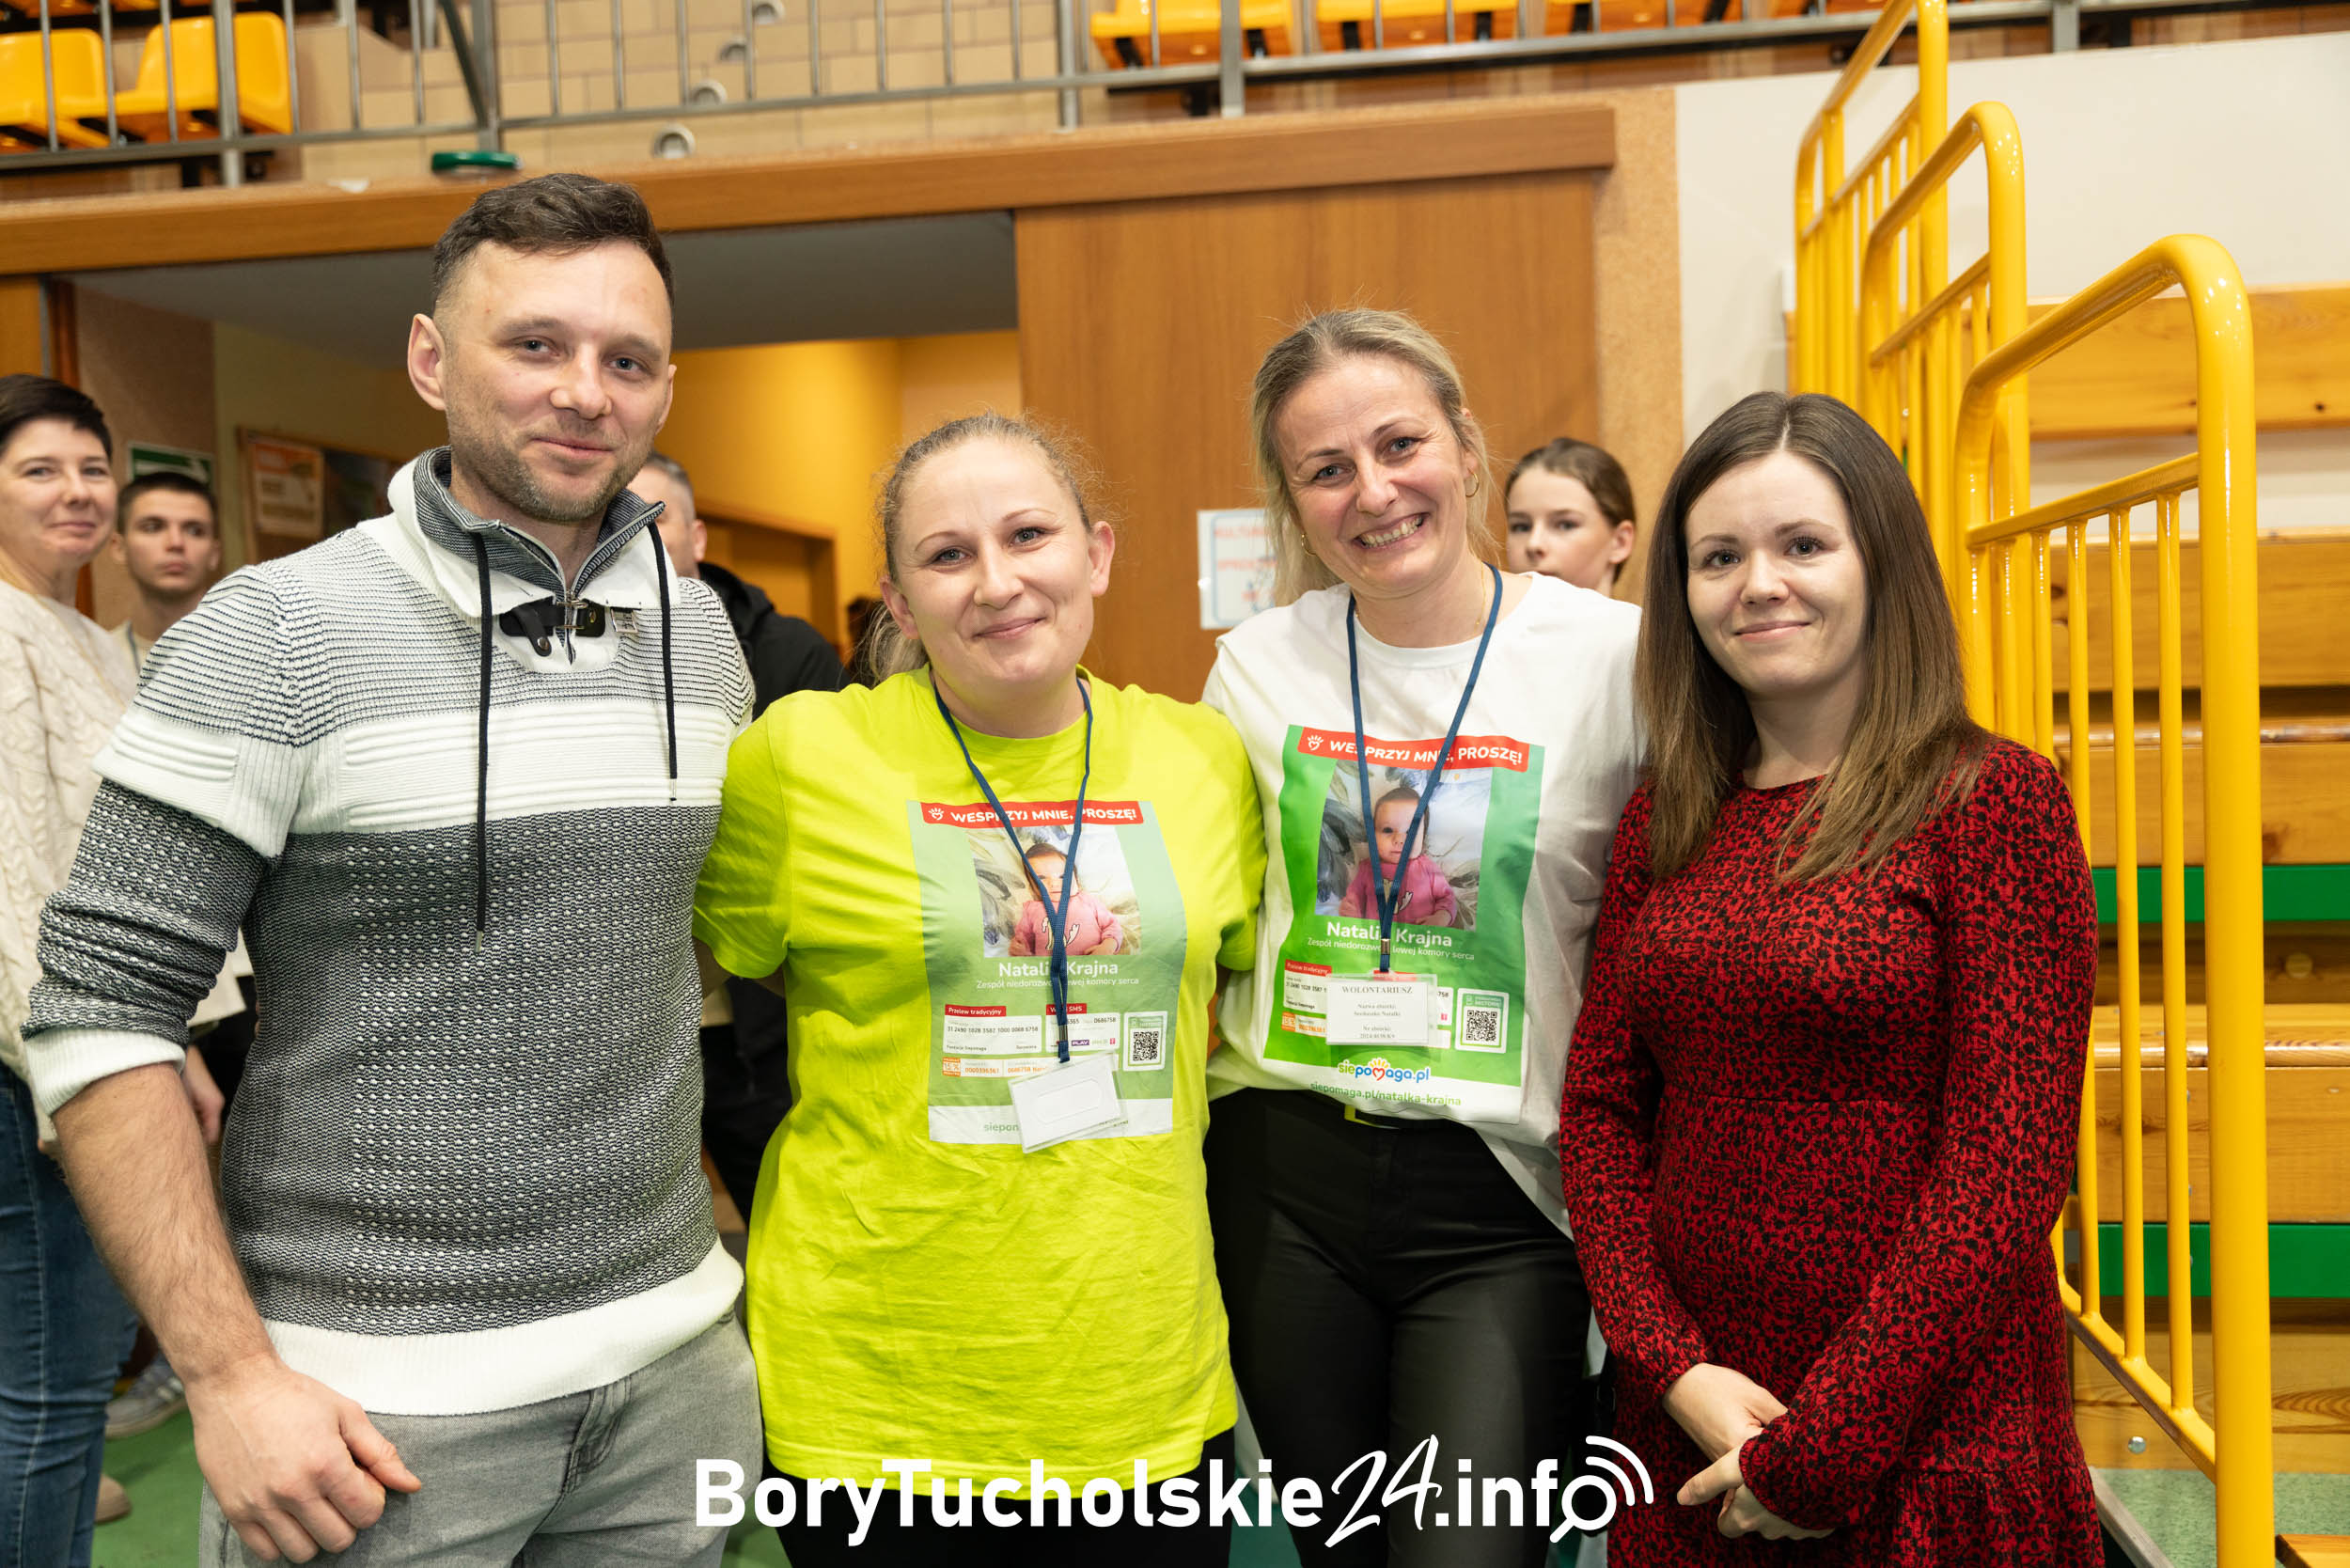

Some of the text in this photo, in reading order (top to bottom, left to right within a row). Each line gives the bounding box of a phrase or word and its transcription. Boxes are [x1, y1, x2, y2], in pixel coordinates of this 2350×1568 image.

[1329, 740, 1523, 766] WEPRZYJ MN, PROSZĘ!
[1032, 809, 1073, 821] MNIE,
[1326, 921, 1452, 949] Natali Krajna
[1308, 937, 1332, 948] Zespół
[1333, 940, 1382, 951] niedorozwo
[1418, 948, 1450, 958] komory
[1452, 951, 1475, 961] serca
[999, 961, 1119, 979] Natali Krajna
[977, 980, 1005, 990] Zespół
[1006, 978, 1054, 988] niedorozwo
[1341, 985, 1413, 994] WOLONTARIUSZ
[1339, 1059, 1430, 1083] siepomaga.pl
[1310, 1081, 1462, 1107] siepomaga.pl/natalka-krajna
